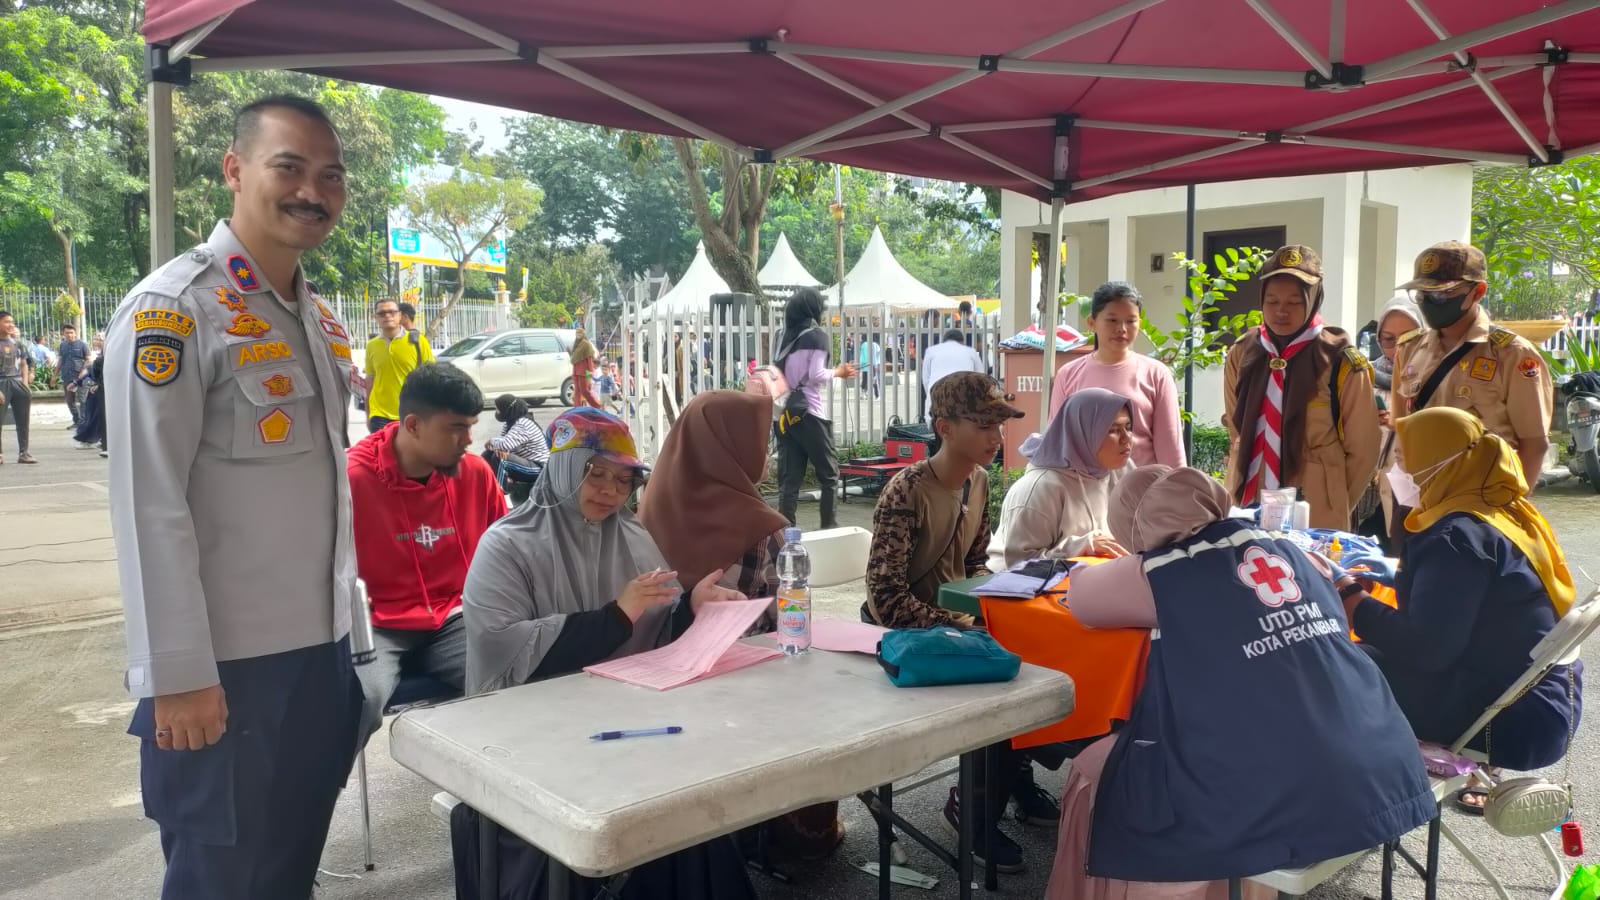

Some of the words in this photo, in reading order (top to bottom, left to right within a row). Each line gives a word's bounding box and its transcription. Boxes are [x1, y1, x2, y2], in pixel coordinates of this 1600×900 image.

[239, 341, 292, 365] ARSO
[1258, 609, 1295, 633] UTD
[1294, 602, 1323, 621] PMI
[1242, 634, 1284, 659] KOTA
